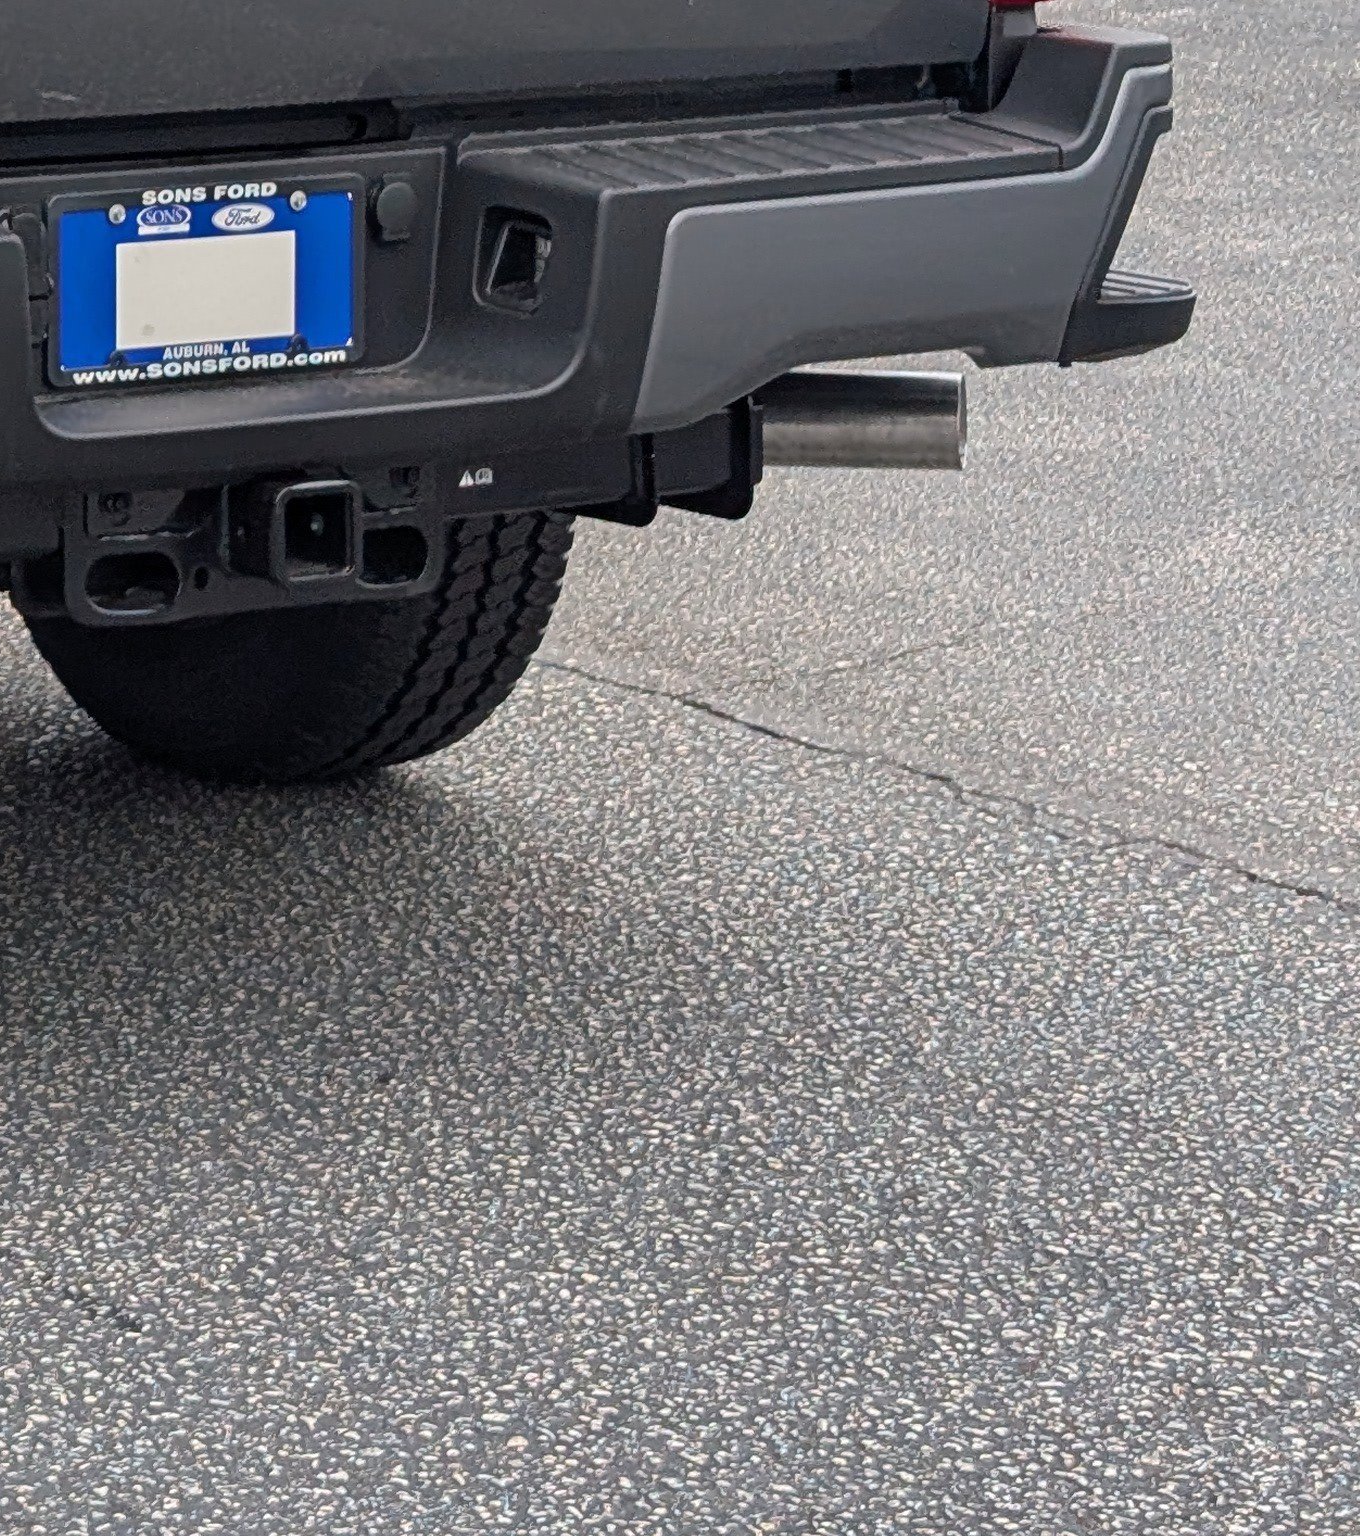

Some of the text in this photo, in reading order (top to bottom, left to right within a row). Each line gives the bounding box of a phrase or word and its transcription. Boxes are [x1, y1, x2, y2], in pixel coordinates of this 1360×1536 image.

[141, 181, 278, 206] SONS FORD
[145, 208, 183, 225] SONS
[224, 207, 262, 227] Ford
[163, 342, 251, 361] AUBURN, AL
[72, 348, 347, 386] www.SONSFORD.com
